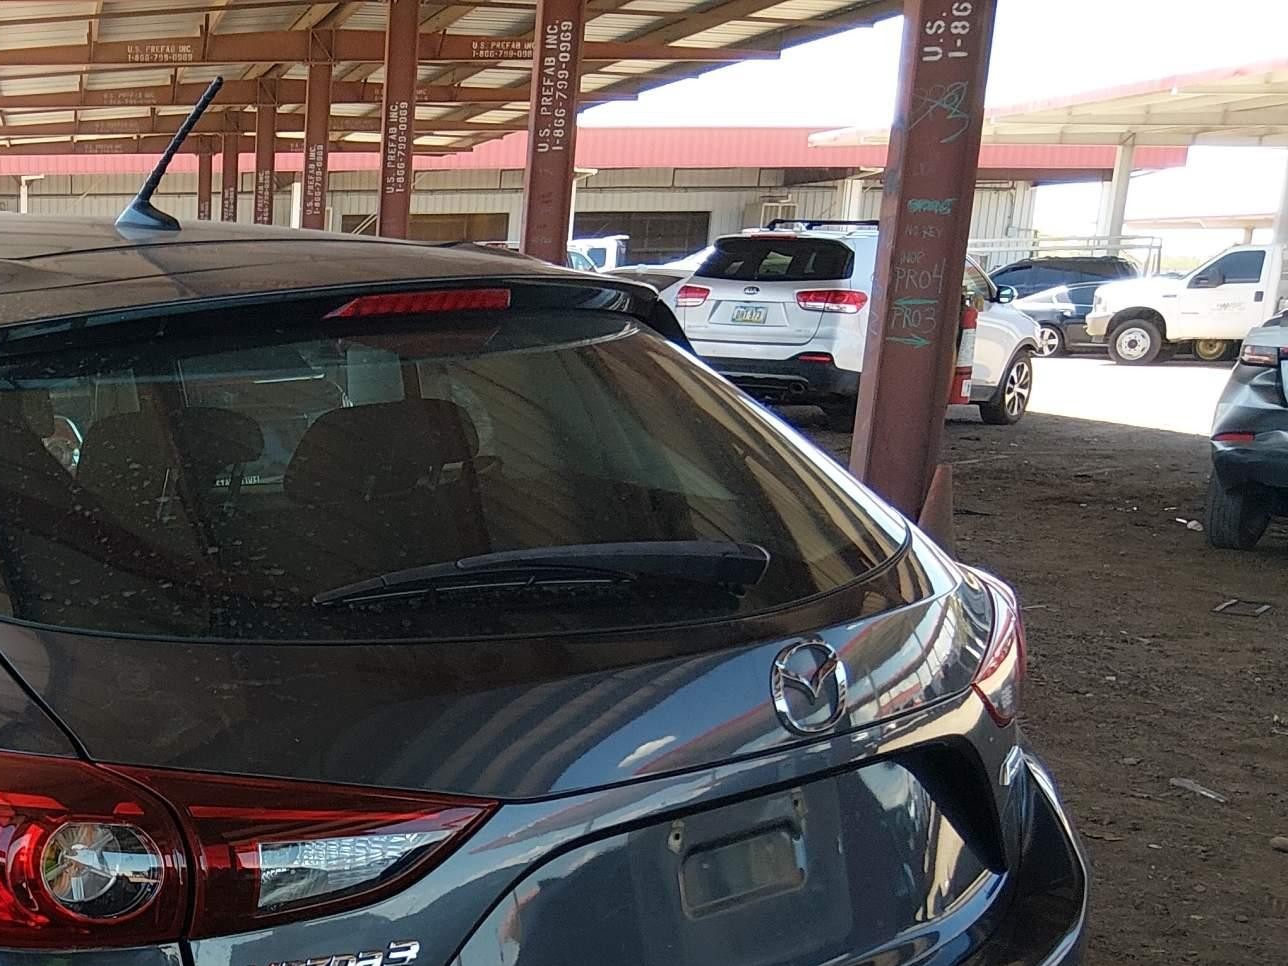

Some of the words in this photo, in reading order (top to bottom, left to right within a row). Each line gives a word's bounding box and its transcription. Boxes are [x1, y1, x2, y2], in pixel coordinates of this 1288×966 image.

[490, 41, 521, 50] PREFAB
[545, 19, 559, 49] INC.
[922, 12, 946, 61] U.S.
[145, 45, 176, 54] PREFAB
[540, 57, 556, 115] PREFAB
[551, 21, 573, 151] 1-866-799-0969
[389, 101, 399, 122] INC.
[387, 127, 397, 168] PREFAB
[537, 124, 552, 152] U.S.
[307, 164, 315, 196] PREFAB
[385, 173, 395, 194] U.S.
